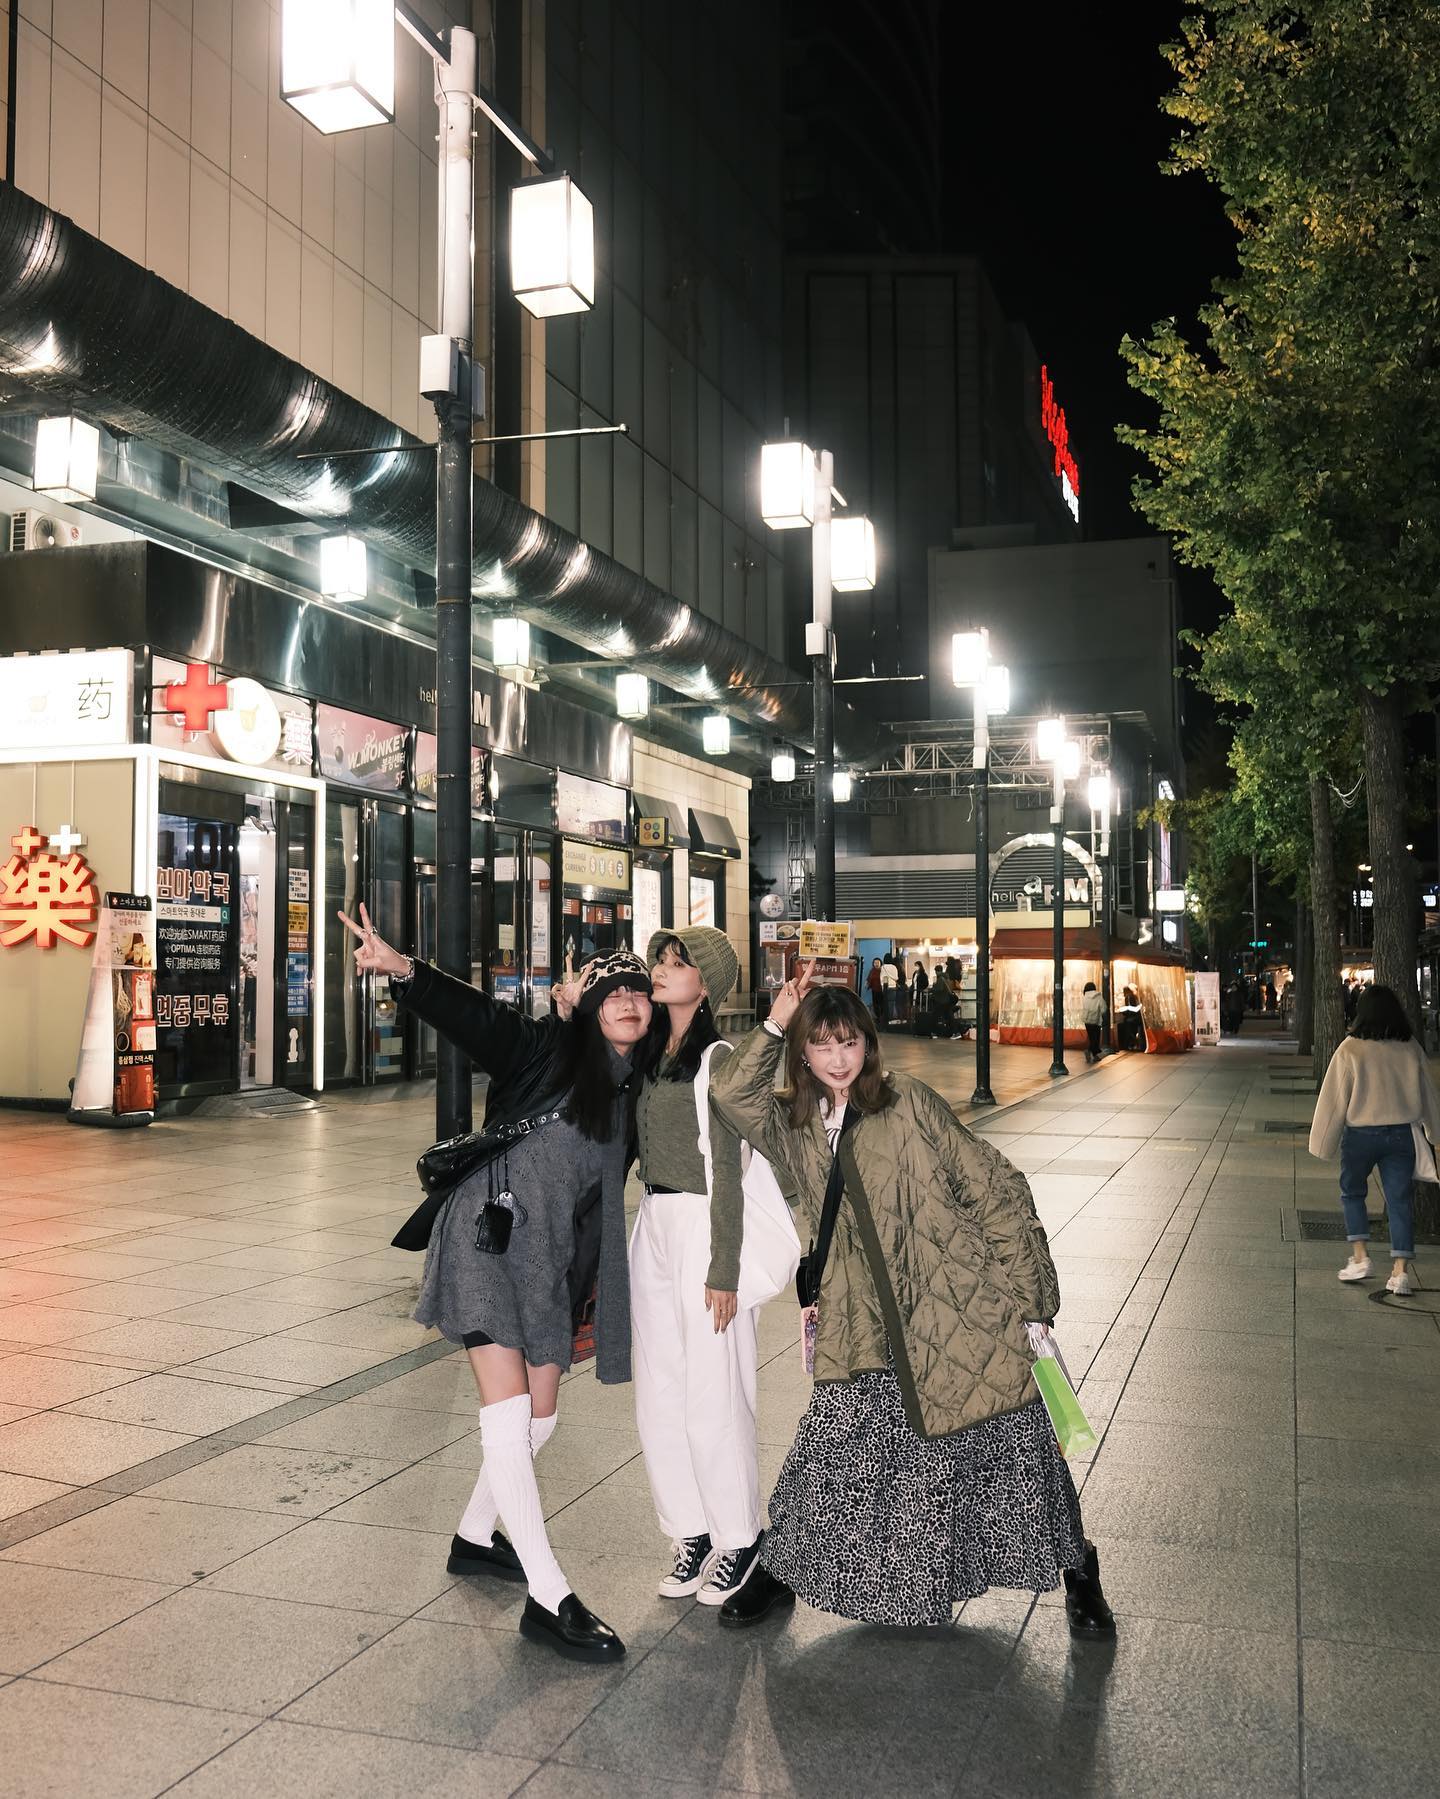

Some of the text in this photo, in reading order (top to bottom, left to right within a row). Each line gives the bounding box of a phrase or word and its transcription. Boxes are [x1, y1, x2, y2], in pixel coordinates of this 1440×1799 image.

[77, 676, 115, 720] 药
[171, 944, 196, 953] OPTIMA
[157, 994, 229, 1028] 연중무휴
